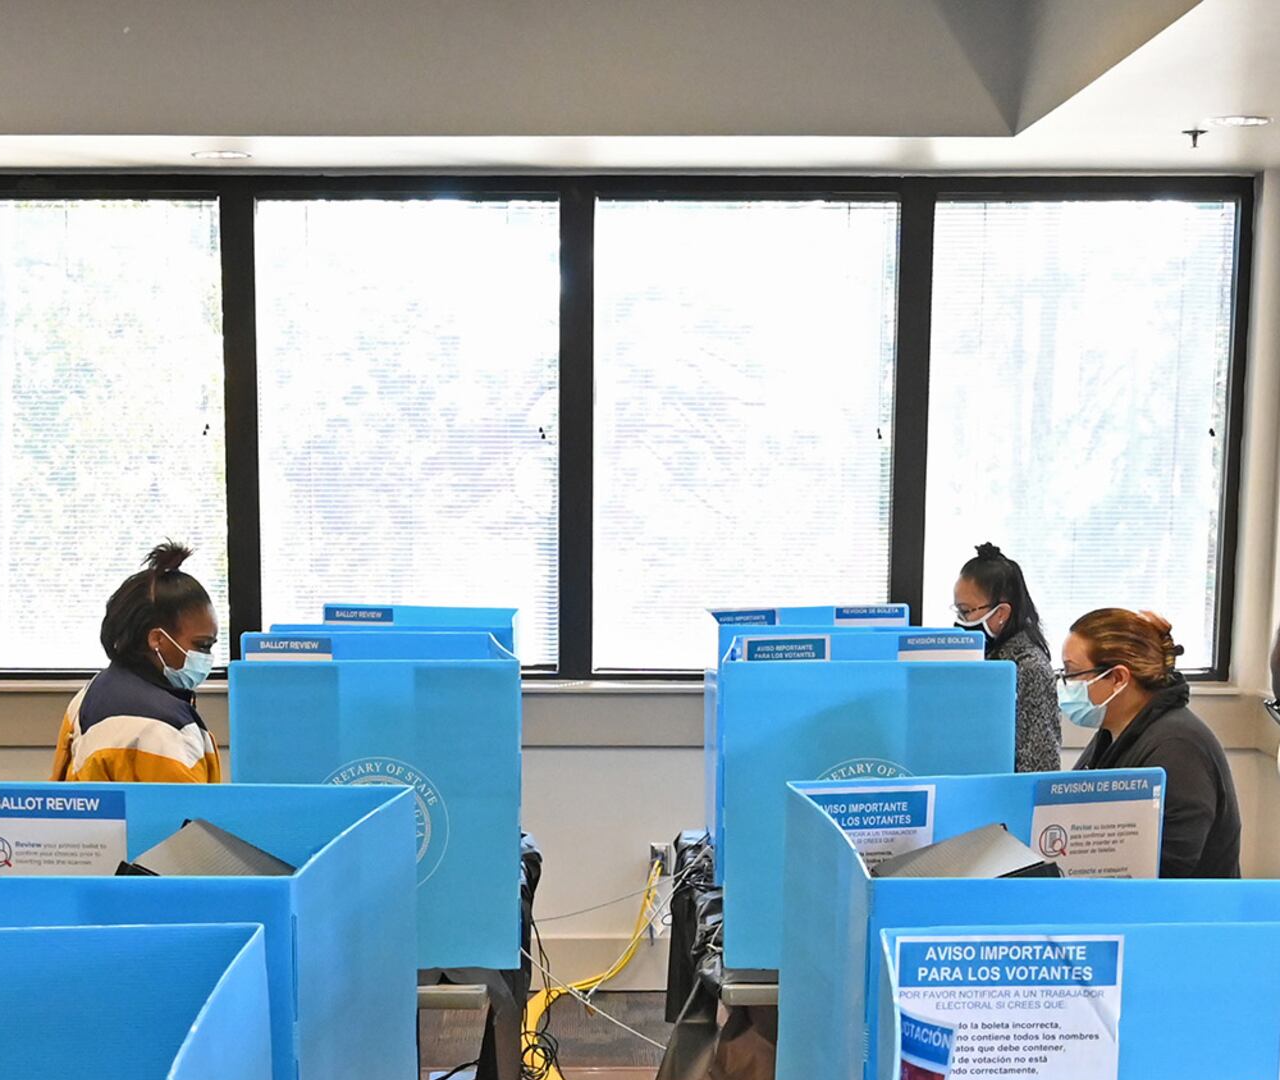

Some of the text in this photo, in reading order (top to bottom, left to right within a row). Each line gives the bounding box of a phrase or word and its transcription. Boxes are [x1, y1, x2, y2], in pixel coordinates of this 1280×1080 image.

[260, 641, 319, 649] BALLOT REVIEW
[907, 637, 936, 645] REVISIÓN
[937, 637, 945, 645] DE
[877, 765, 896, 777] OF
[329, 762, 438, 806] RETARY OF STATE
[1050, 780, 1148, 794] REVISIÓN DE BOLETA
[46, 798, 100, 811] REVIEW
[819, 802, 908, 814] AVISO IMPORTANTE
[841, 815, 911, 827] LOS VOTANTES
[925, 946, 1087, 961] AVISO IMPORTANTE
[917, 966, 1093, 982] PARA LOS VOTANTES
[899, 989, 1104, 999] POR FAVOR NOTIFICAR UN TRABAJADOR
[935, 1001, 1041, 1010] ELECTORAL SI CREES
[970, 1021, 1062, 1030] la boleta incorrecta,
[971, 1033, 1011, 1041] contiene
[1013, 1032, 1039, 1041] todos
[1042, 1032, 1056, 1041] los
[1058, 1032, 1100, 1041] nombres
[977, 1044, 1066, 1054] que debe contener,
[958, 1056, 969, 1064] de
[972, 1055, 1012, 1064] votación
[1028, 1055, 1048, 1063] está
[970, 1066, 1039, 1076] correctamente,
